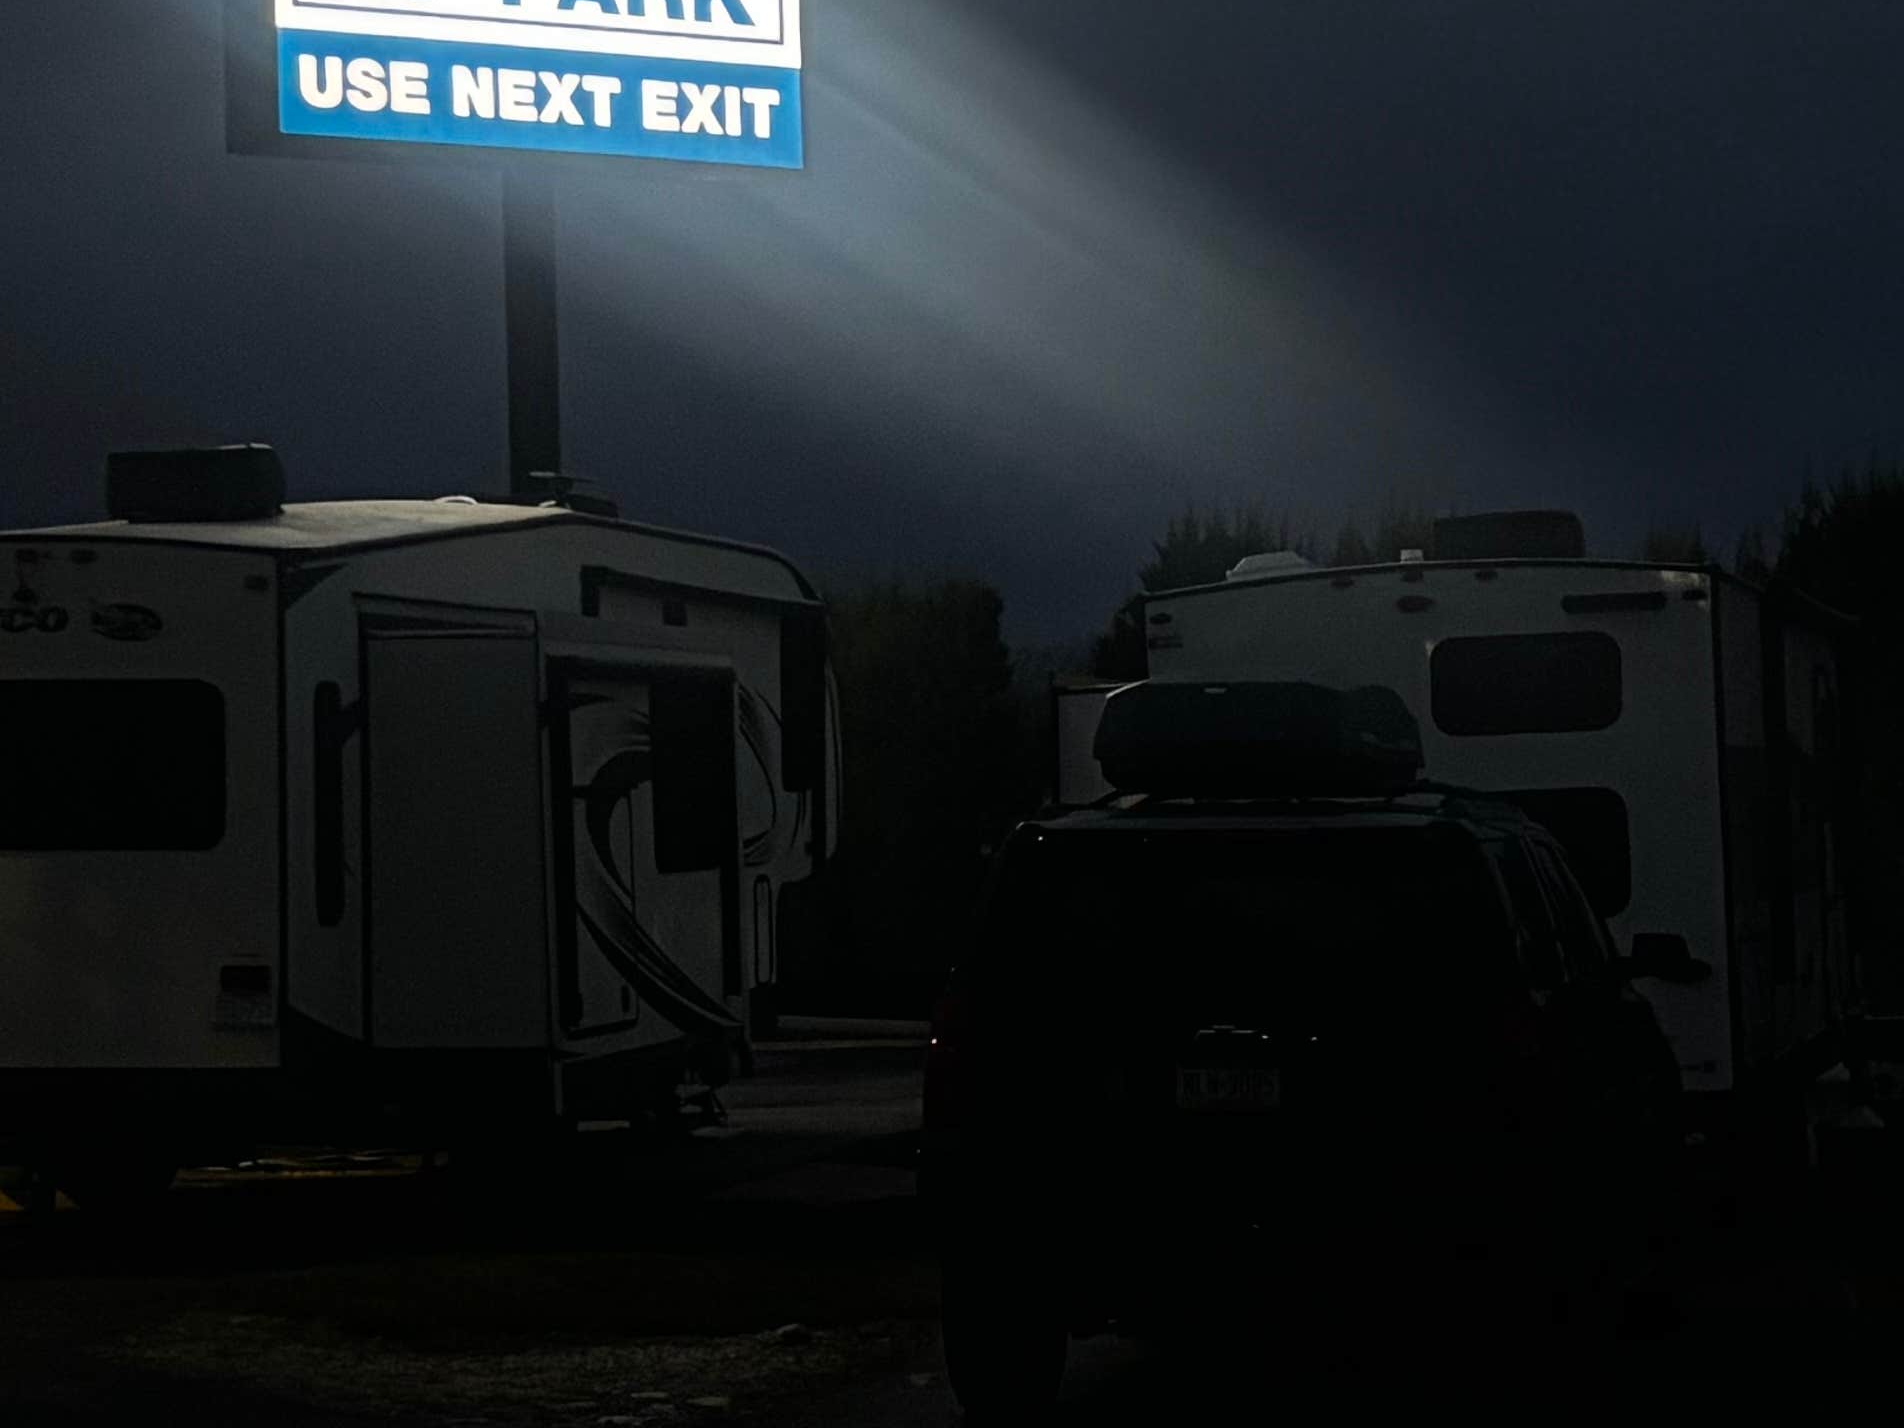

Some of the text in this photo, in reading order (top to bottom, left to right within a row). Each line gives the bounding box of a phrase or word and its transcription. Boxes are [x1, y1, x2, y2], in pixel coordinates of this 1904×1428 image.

[297, 54, 780, 139] USE NEXT EXIT
